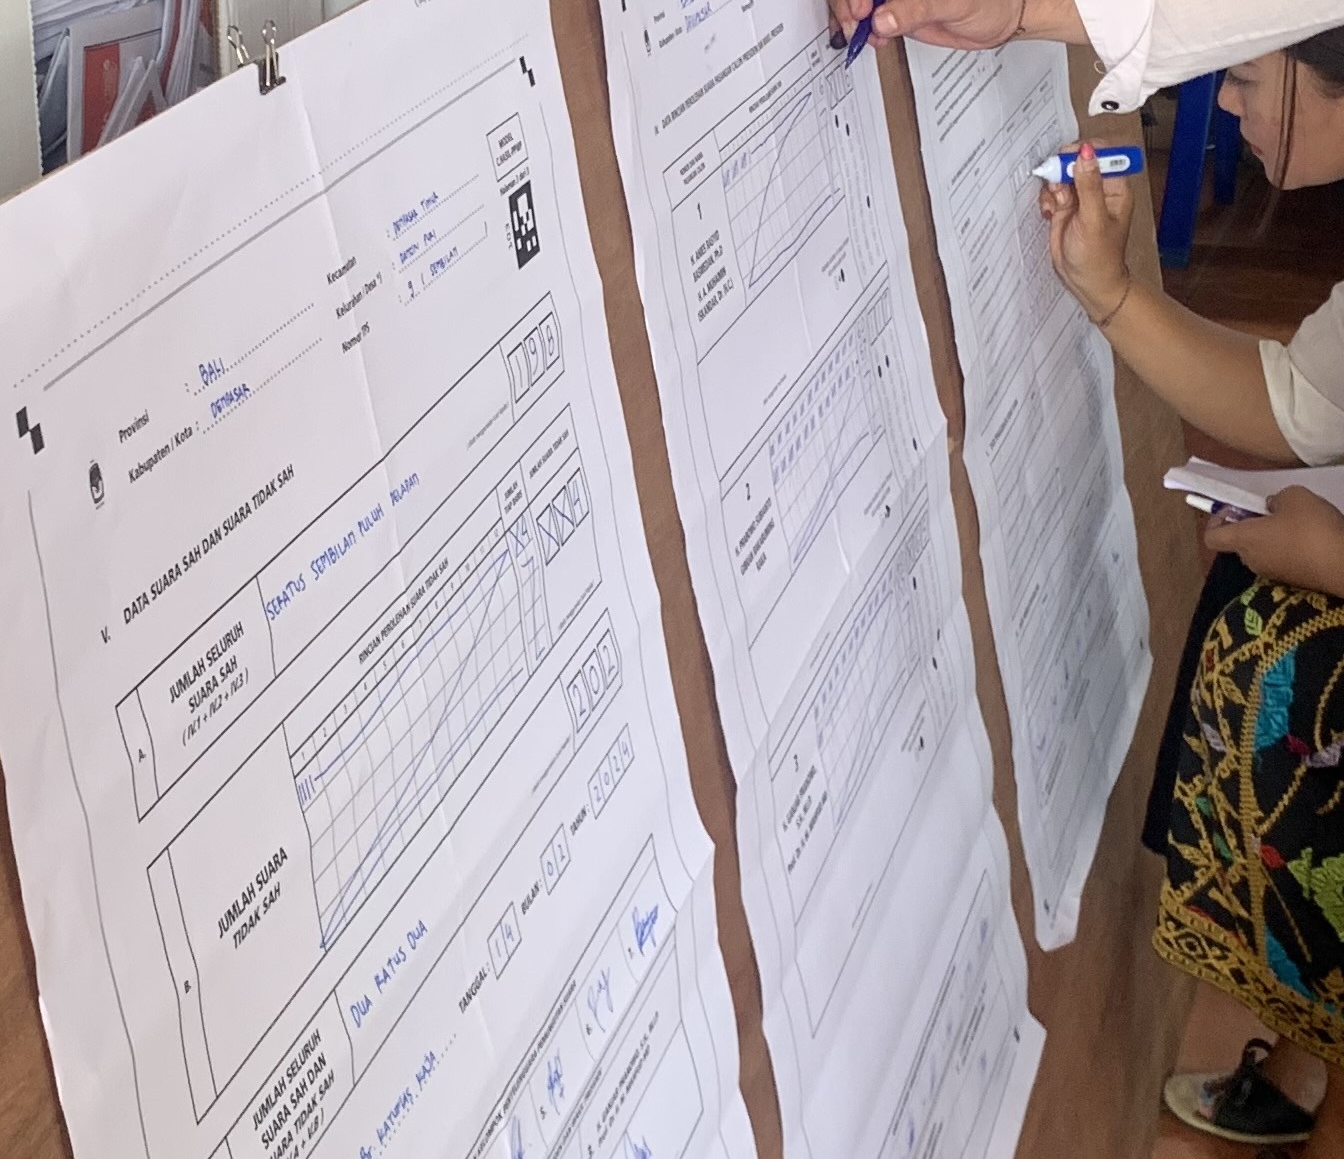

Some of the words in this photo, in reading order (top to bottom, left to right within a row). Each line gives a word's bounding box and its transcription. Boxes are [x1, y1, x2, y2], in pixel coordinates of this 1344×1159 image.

[697, 202, 702, 220] 1
[326, 256, 356, 285] Kecamatan
[336, 290, 363, 319] Kelurahan
[342, 333, 362, 354] Nomor
[361, 321, 370, 338] TPS
[118, 409, 150, 443] Provinsi
[198, 357, 225, 385] BALI
[128, 445, 171, 483] Kabupaten
[175, 425, 193, 446] Kota
[101, 625, 111, 644] V.
[123, 591, 150, 625] DATA
[150, 562, 182, 601] SUARA
[182, 545, 202, 572] SAH
[202, 527, 222, 553] DAN
[222, 502, 252, 537] SUARA
[252, 480, 276, 509] TIDAK
[276, 463, 295, 489] SAH
[357, 503, 385, 537] PULUH
[358, 633, 381, 665] RINCIAN
[380, 601, 412, 643] PEROLEHAN
[410, 585, 426, 608] SUARA
[424, 571, 439, 591] TIDAK
[438, 558, 449, 574] SAH
[169, 658, 206, 704] JUMLAH
[206, 621, 244, 667] SELURUH
[188, 676, 219, 714] SUARA
[220, 655, 238, 683] SAH
[217, 884, 255, 939] JUMLAH
[255, 847, 288, 891] SUARA
[233, 906, 260, 949] TIDAK
[263, 882, 281, 915] SAH
[350, 995, 373, 1028] DUA
[374, 948, 407, 993] RATUS
[406, 919, 428, 950] DUA
[253, 1076, 286, 1131] JUMLAH
[286, 1028, 321, 1084] SELURUH
[262, 1105, 291, 1150] SUARA
[290, 1078, 308, 1110] SAH
[307, 1053, 326, 1085] DAN
[270, 1130, 293, 1159] UARA
[294, 1093, 317, 1134] TIDAK
[319, 1069, 334, 1100] SAH
